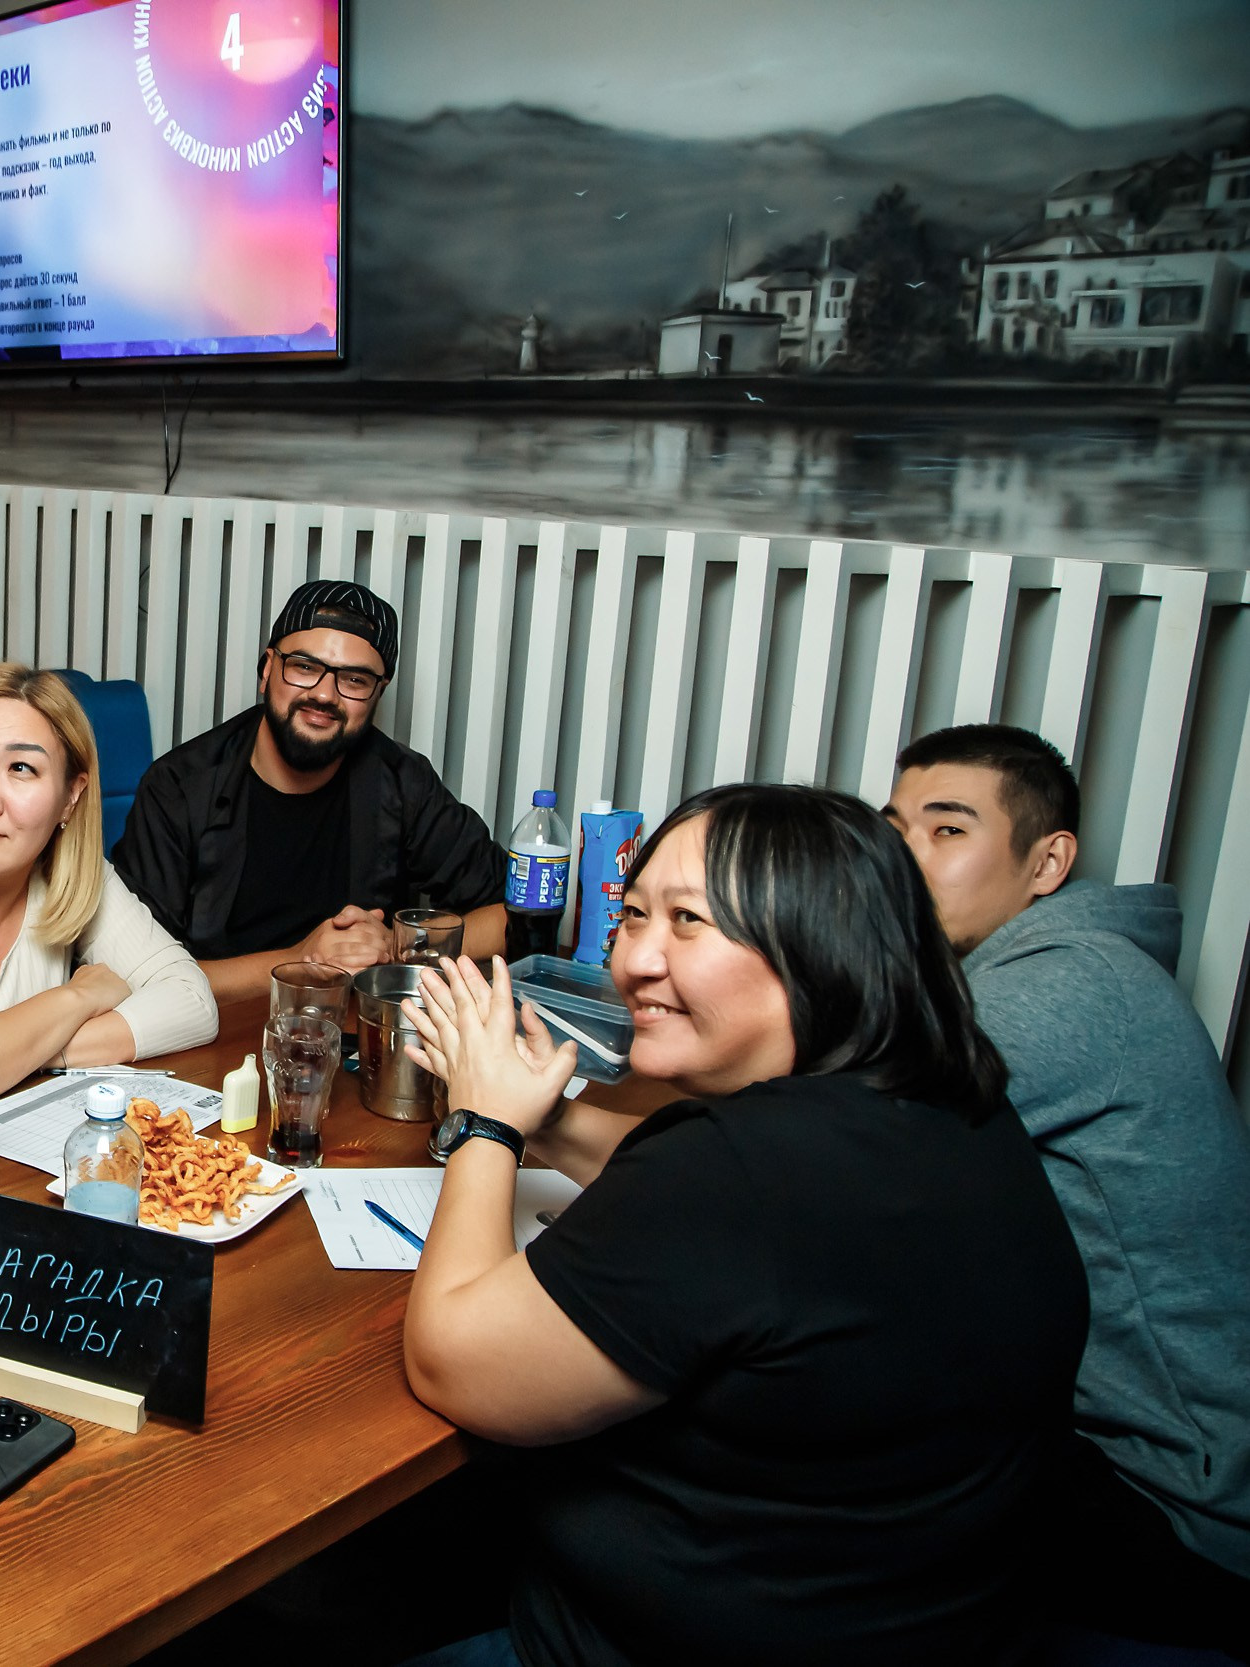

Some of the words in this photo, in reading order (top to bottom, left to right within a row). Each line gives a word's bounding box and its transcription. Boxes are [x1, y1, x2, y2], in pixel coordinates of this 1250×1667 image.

[133, 0, 151, 50] КИН
[220, 12, 245, 71] 4
[136, 54, 169, 125] ACTION
[302, 65, 327, 119] ВИЗ
[19, 133, 51, 151] фильмы
[52, 132, 58, 142] и
[60, 129, 70, 141] не
[72, 123, 99, 139] только
[101, 121, 111, 133] по
[163, 119, 241, 172] КИНОКВИЗ
[246, 110, 304, 168] ACTION
[2, 160, 40, 177] подсказок
[49, 156, 63, 170] год
[64, 150, 97, 166] выхода,
[21, 188, 27, 198] и
[40, 271, 50, 286] 30
[51, 271, 79, 285] секунд
[33, 298, 52, 310] ответ
[61, 293, 65, 307] 1
[67, 293, 87, 307] балл
[67, 319, 95, 333] раунда
[539, 868, 550, 903] PEPSI
